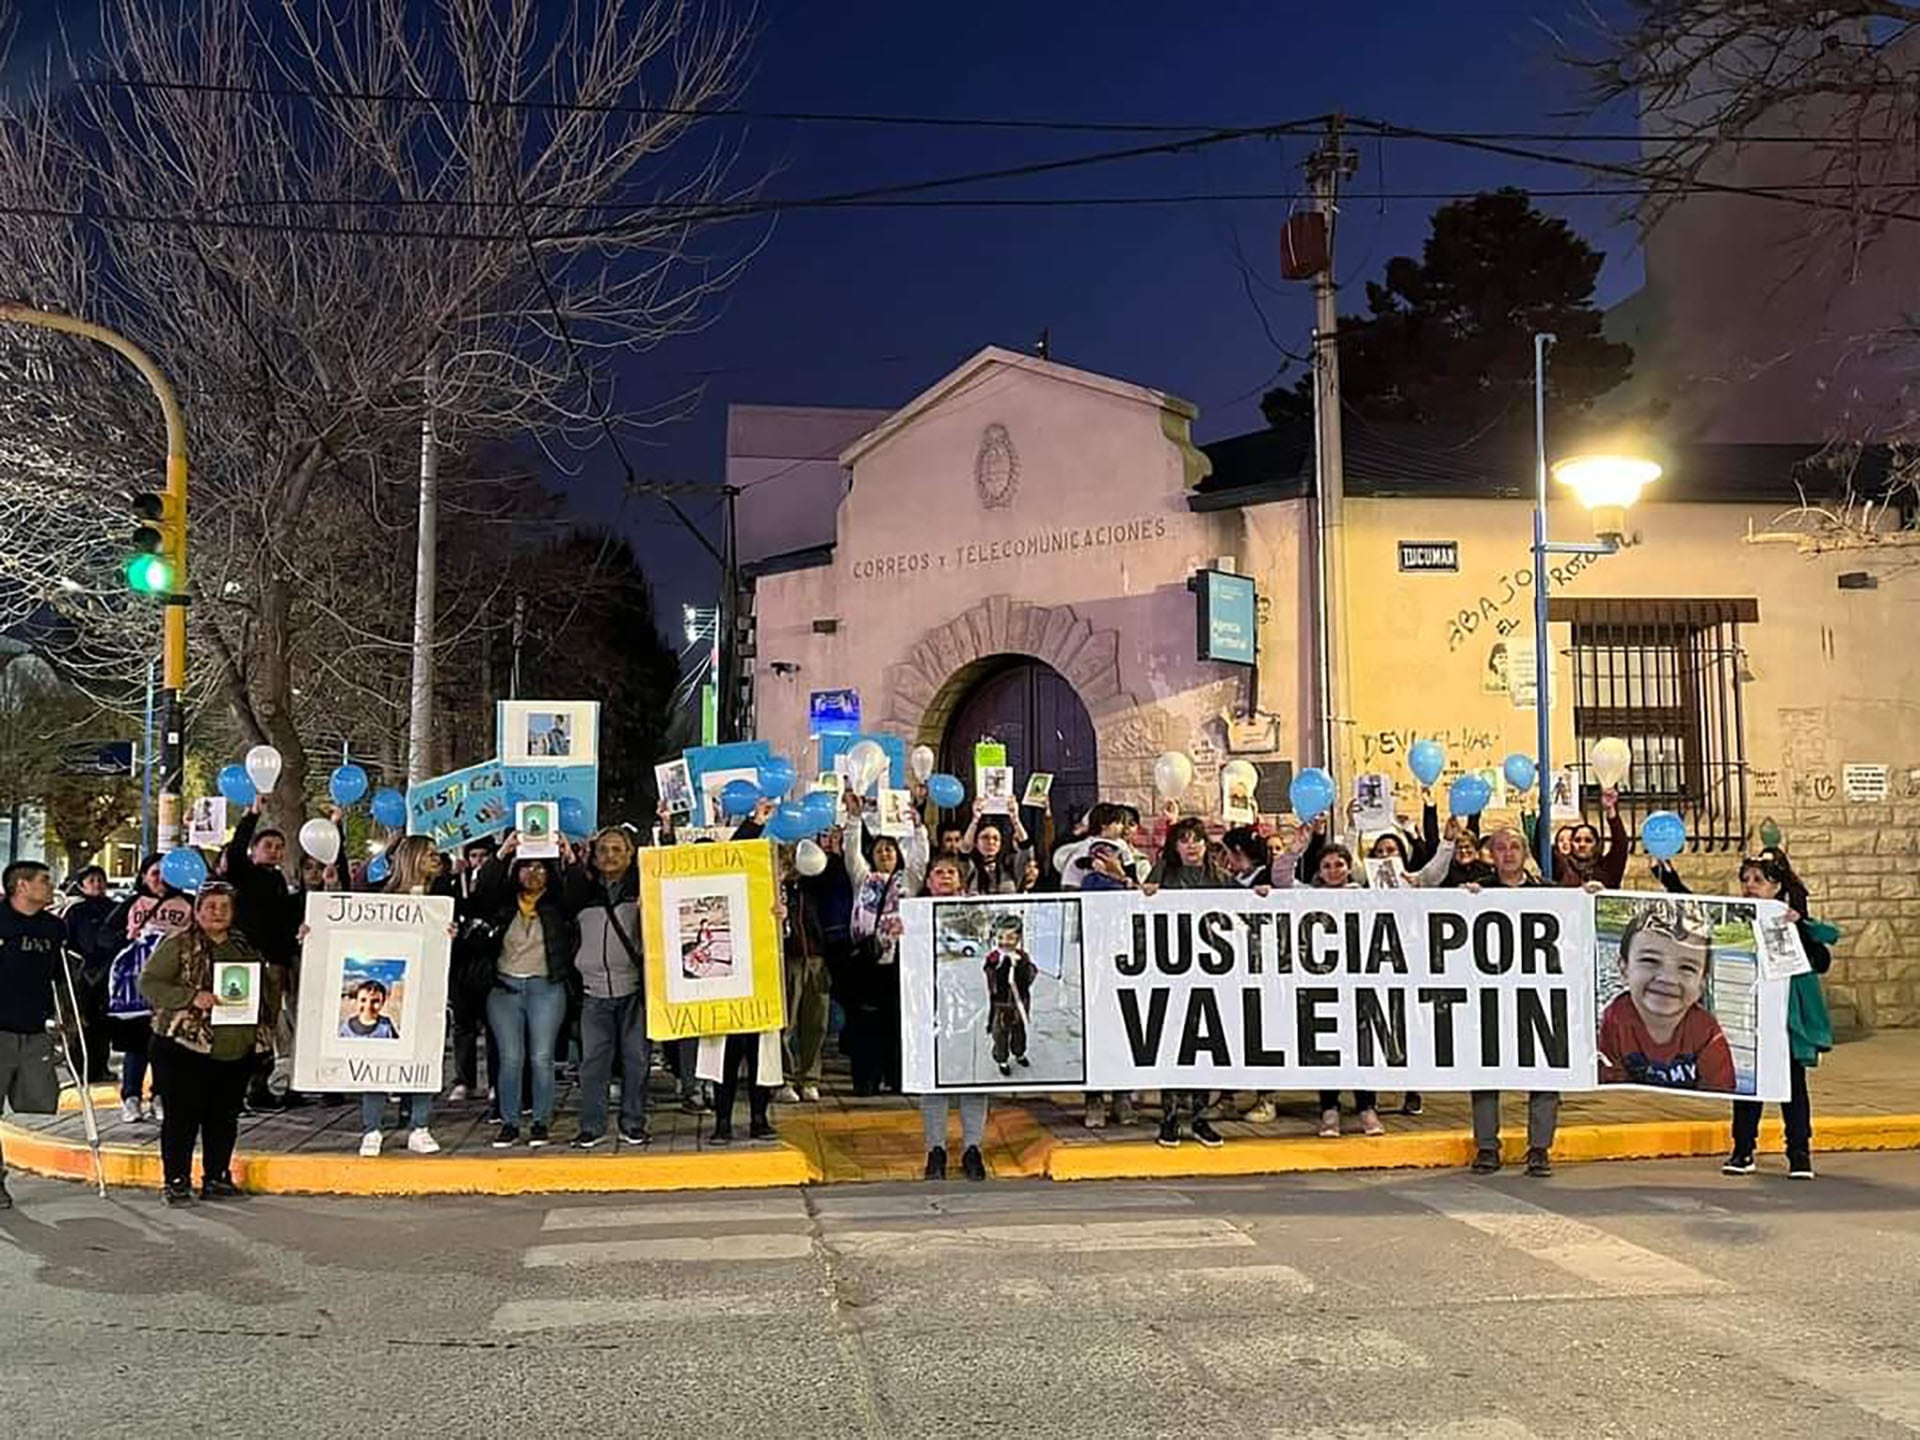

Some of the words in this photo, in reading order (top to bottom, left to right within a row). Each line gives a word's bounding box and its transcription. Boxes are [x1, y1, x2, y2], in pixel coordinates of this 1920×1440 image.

[853, 553, 929, 579] CORREOS
[956, 518, 1166, 566] TELECOMUNICACIONES
[1403, 547, 1456, 567] TUCUMAN
[1448, 568, 1534, 652] ABAJO
[651, 849, 745, 879] JUSTICIA
[327, 895, 425, 924] JUSTICIA
[1115, 911, 1409, 976] JUSTICIA
[1428, 911, 1564, 976] POR
[1116, 986, 1571, 1069] VALENTIN
